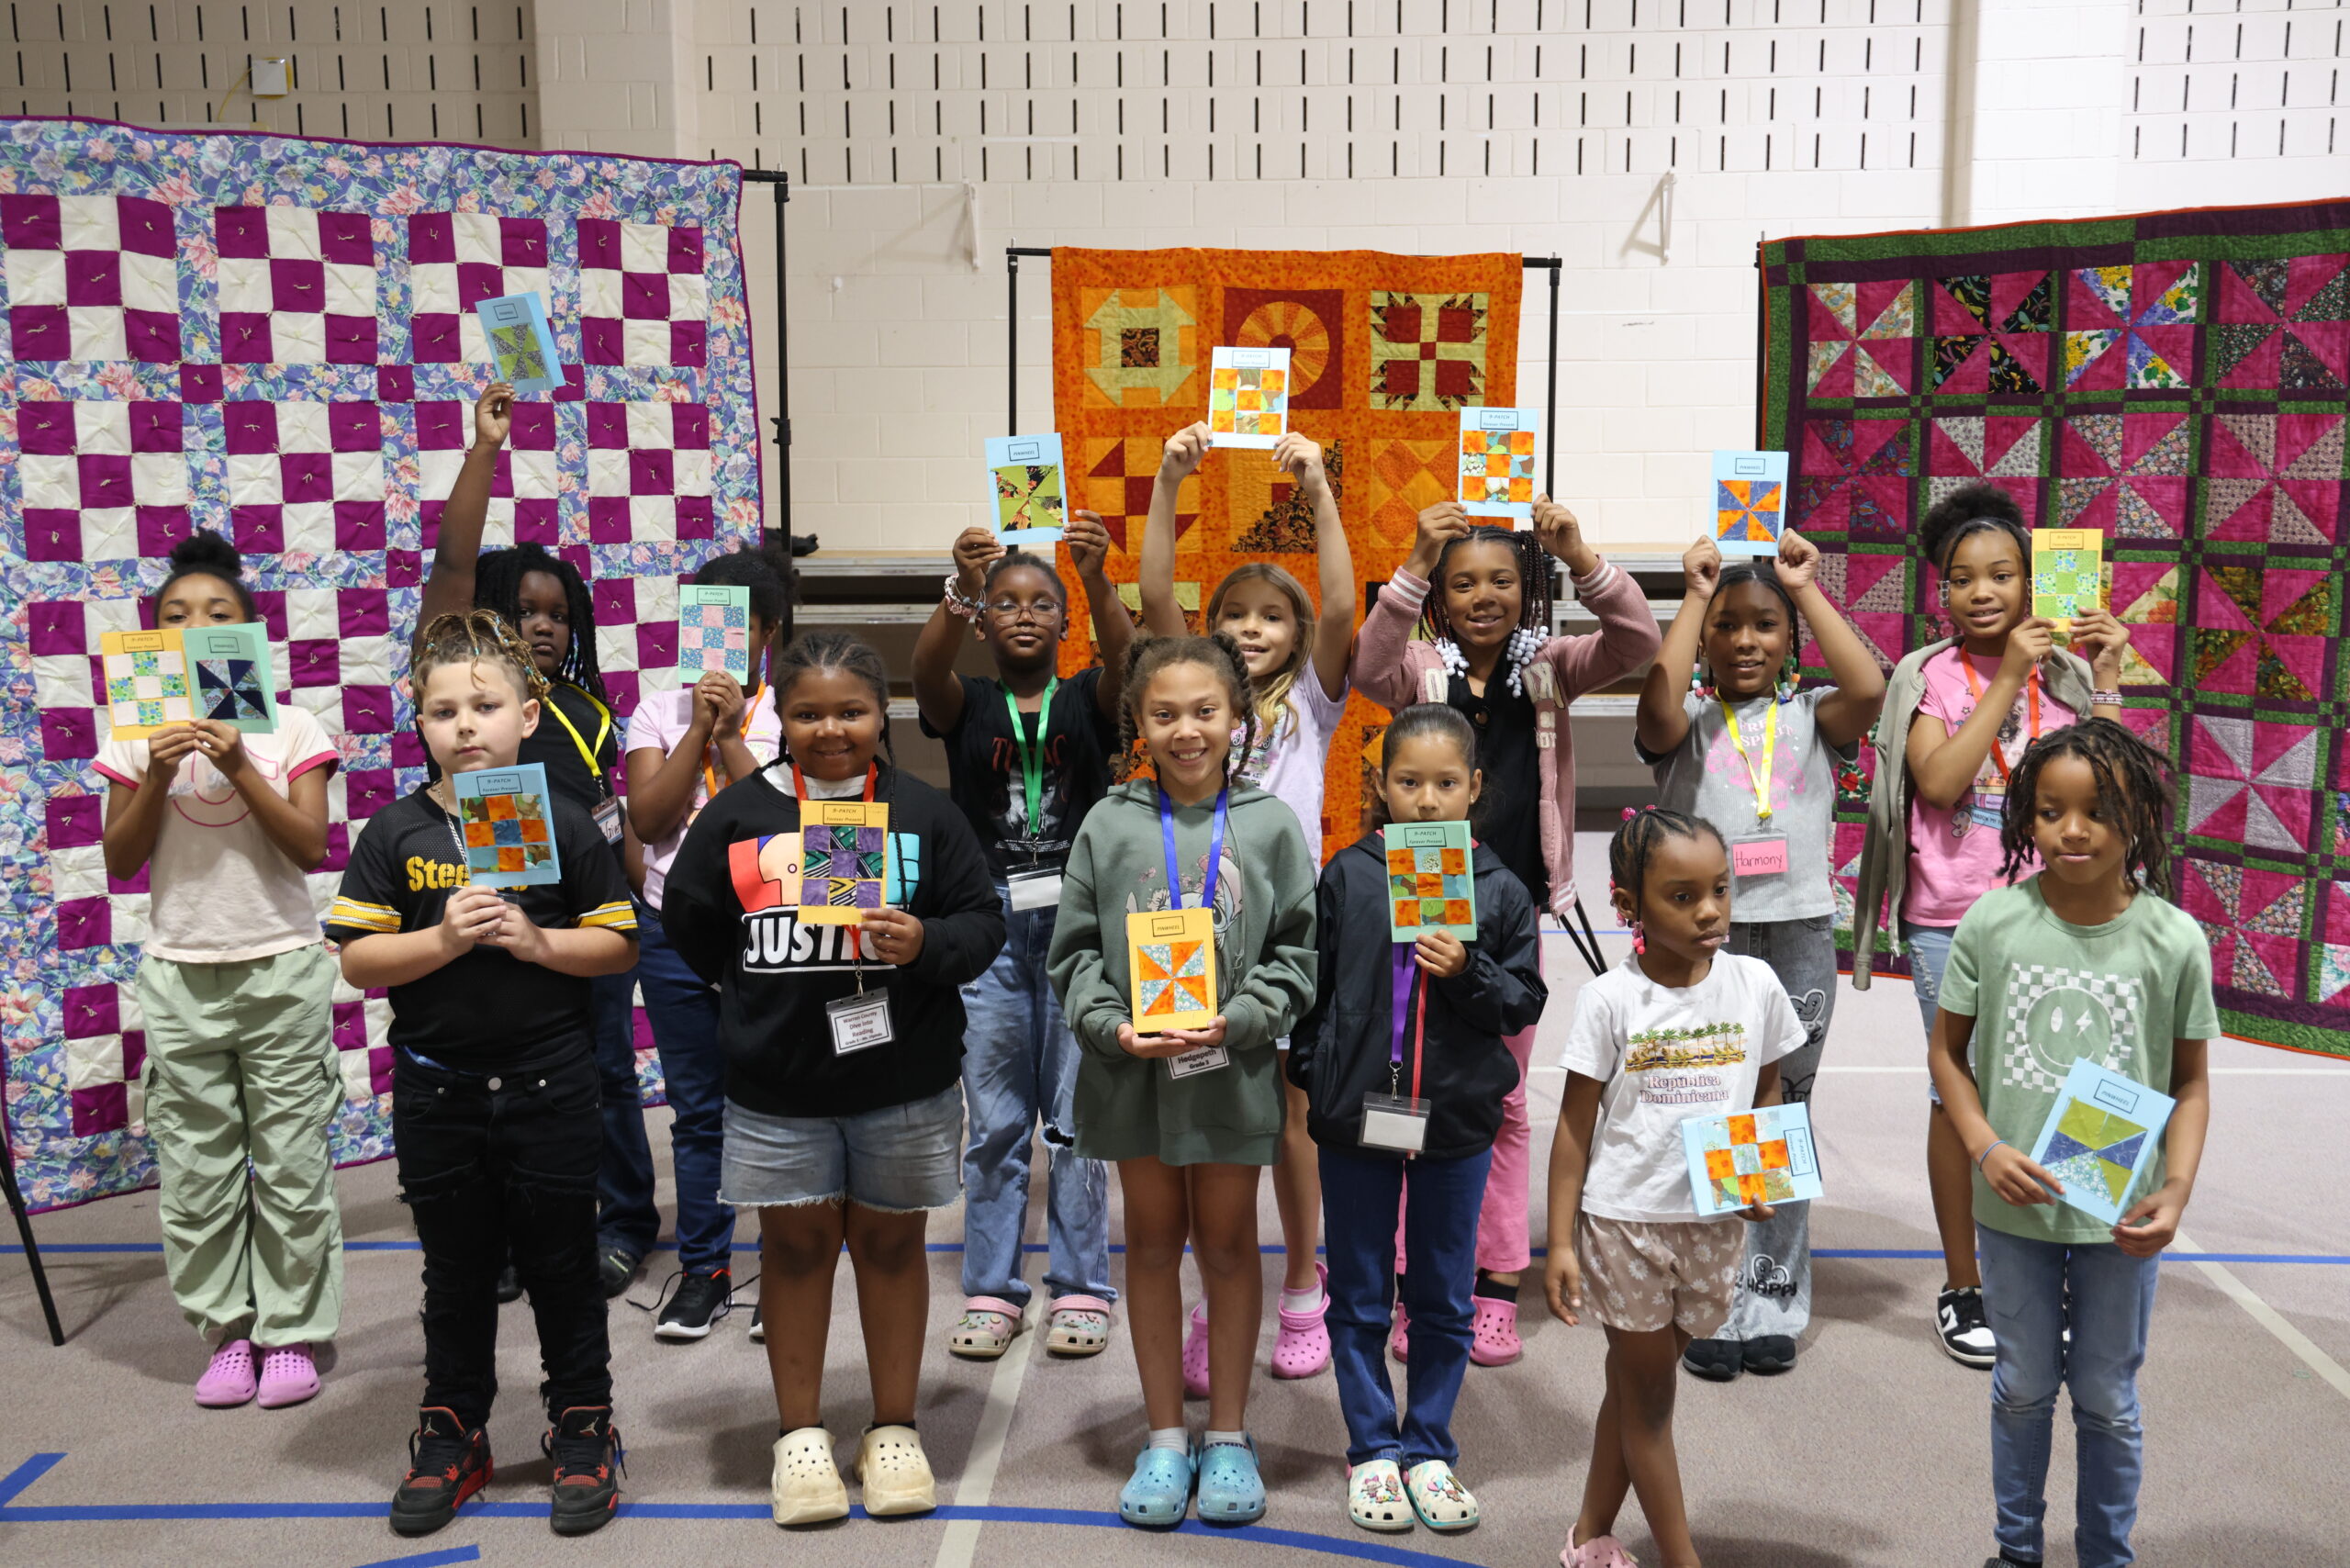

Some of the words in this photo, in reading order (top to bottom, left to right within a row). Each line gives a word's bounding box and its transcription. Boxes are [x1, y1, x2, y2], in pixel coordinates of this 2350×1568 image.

[1735, 851, 1782, 868] Harmony
[843, 1014, 860, 1025] Warren
[861, 1011, 878, 1020] County
[849, 1022, 862, 1030] Dive
[852, 1027, 874, 1038] Reading
[1189, 1060, 1205, 1070] Grade
[1640, 1089, 1729, 1104] Dominicana
[2101, 1090, 2130, 1106] PINWHEEL
[1747, 1278, 1797, 1297] HAPPY
